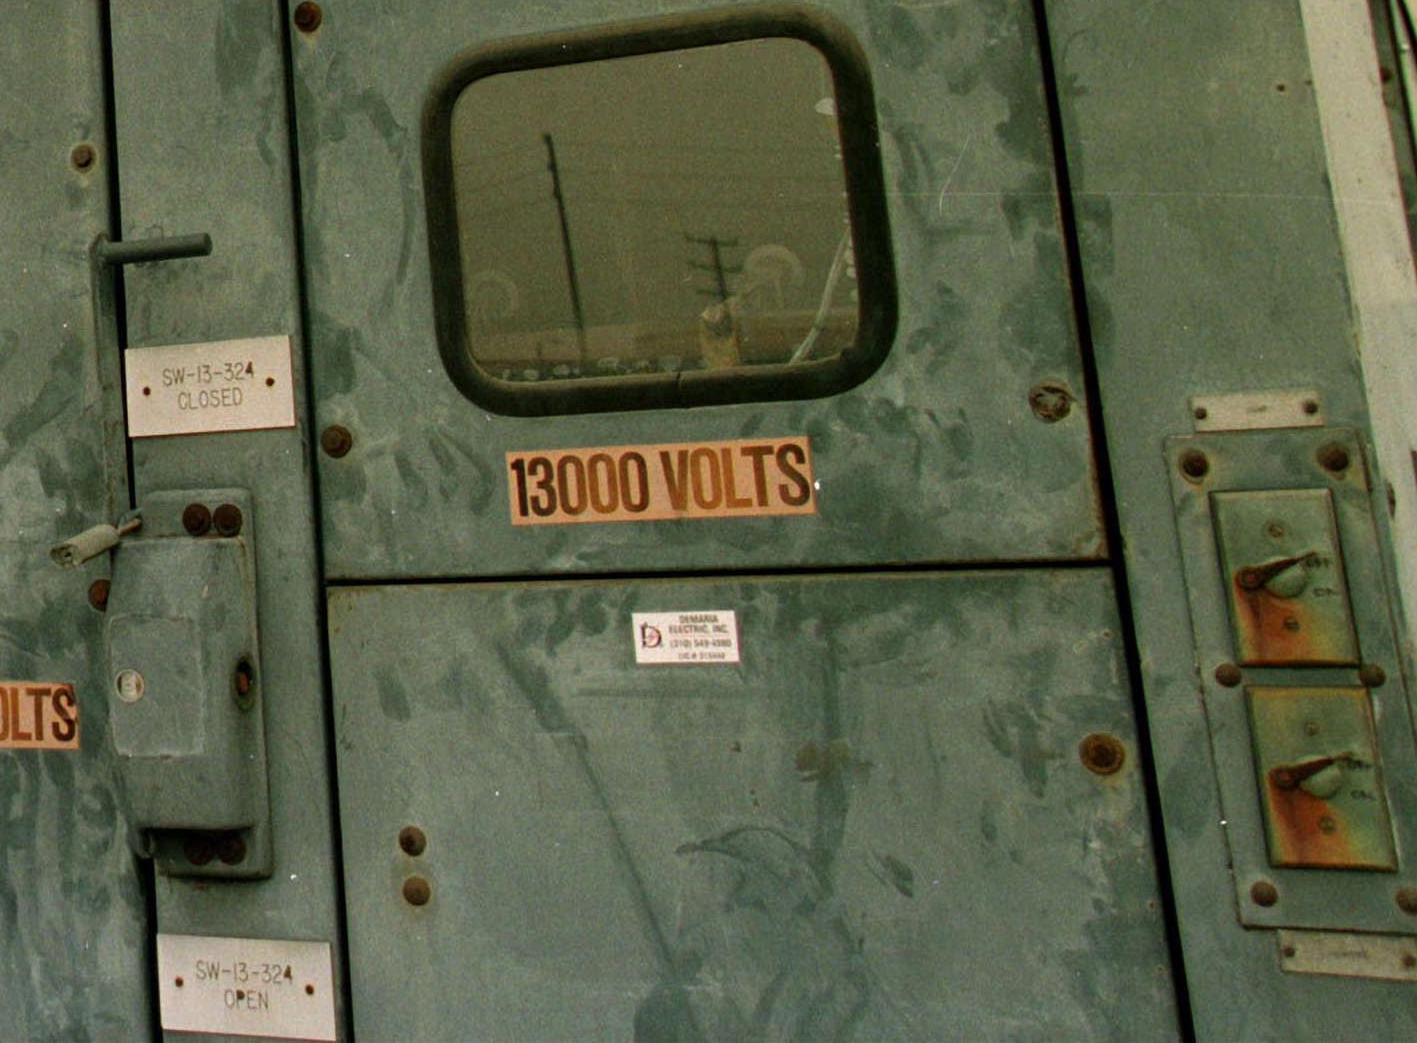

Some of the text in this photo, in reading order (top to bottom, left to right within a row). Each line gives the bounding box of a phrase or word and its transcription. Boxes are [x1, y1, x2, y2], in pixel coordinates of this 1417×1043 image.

[162, 361, 254, 387] SW-13-324
[178, 388, 243, 410] CLOSED
[510, 443, 812, 518] 13000 VOLTS
[196, 960, 293, 985] SW-13-324
[224, 989, 269, 1011] OPEN
